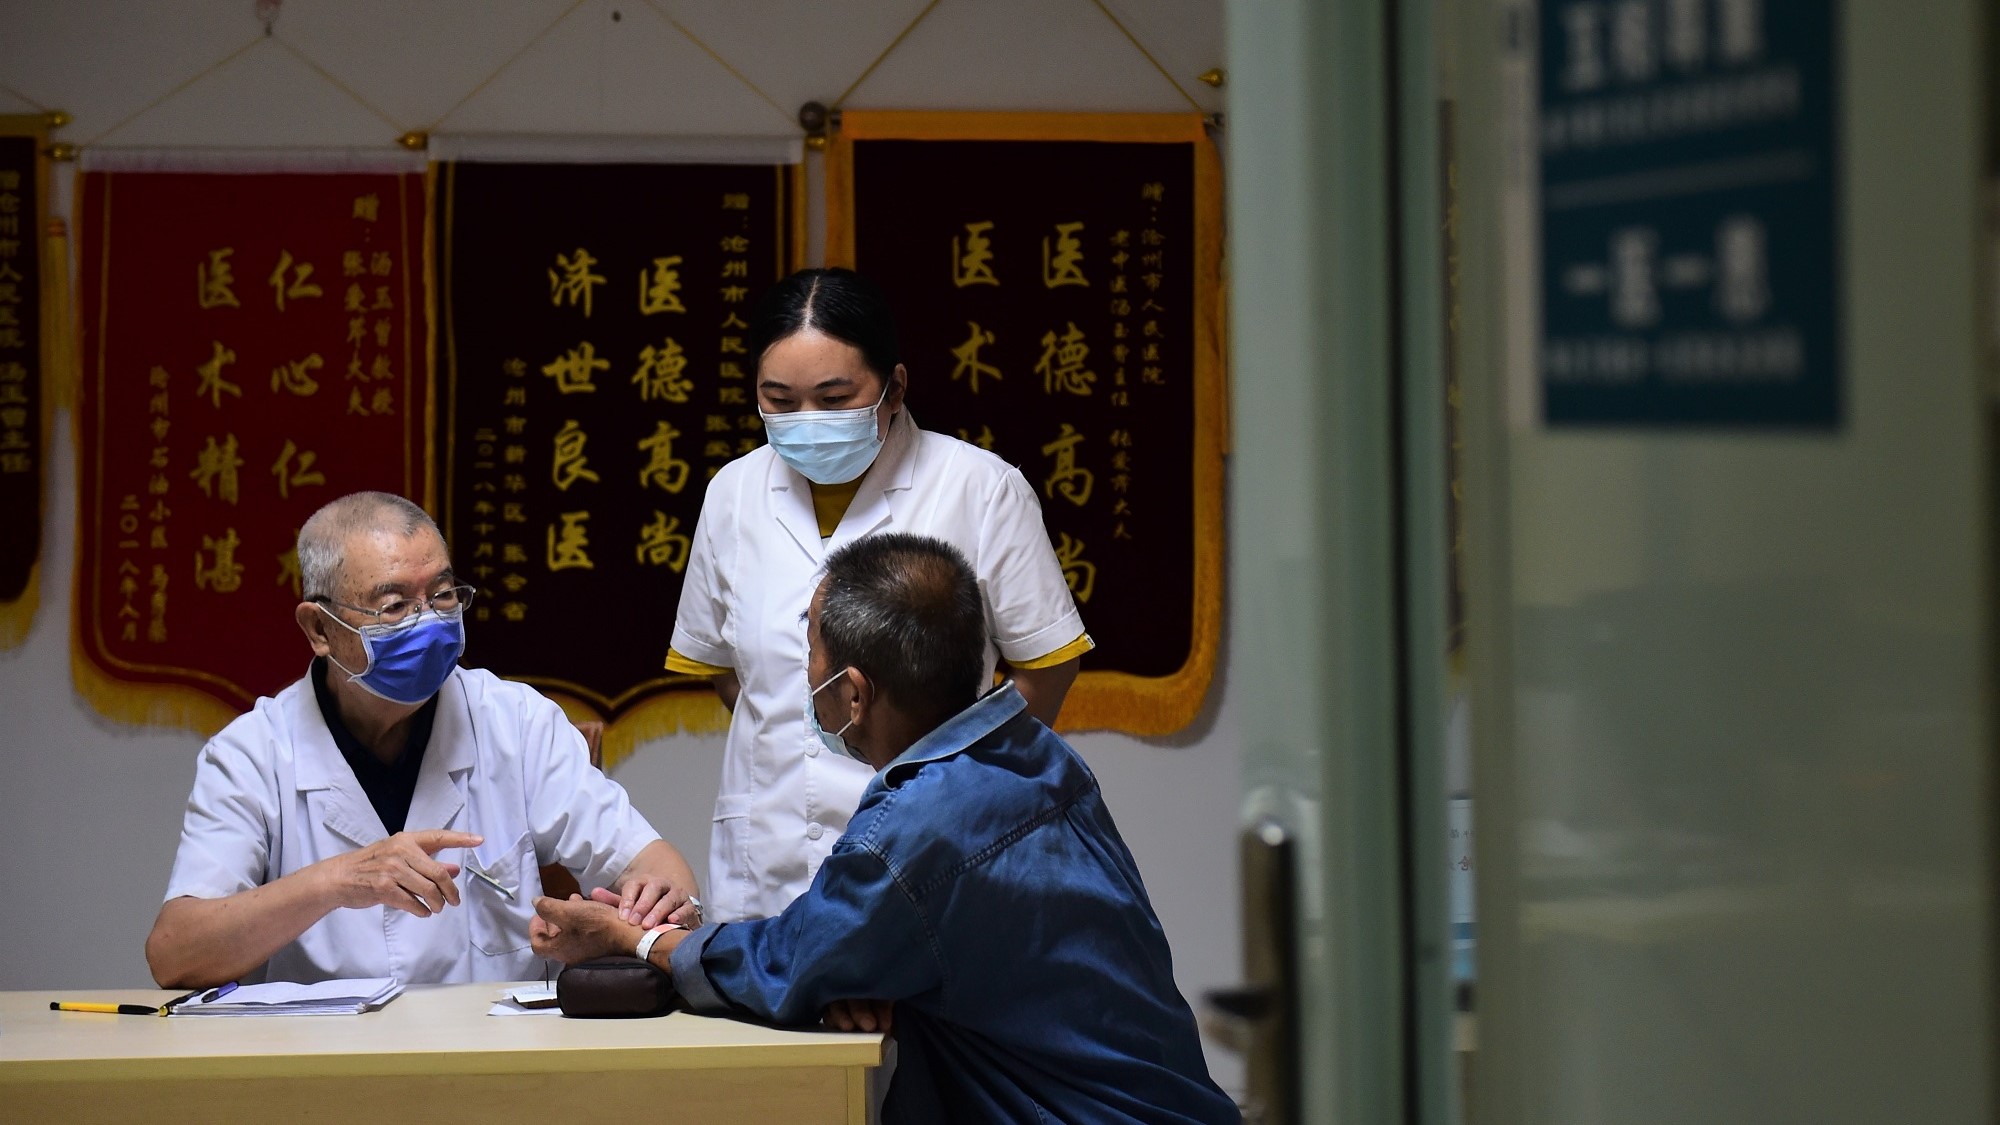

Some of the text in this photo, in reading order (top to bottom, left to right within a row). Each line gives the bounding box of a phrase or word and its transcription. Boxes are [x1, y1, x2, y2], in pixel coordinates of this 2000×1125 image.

[190, 247, 244, 594] 医术精湛
[541, 248, 610, 572] 济世良医
[631, 255, 695, 573] 医德高尚
[951, 221, 1004, 452] 医术
[1034, 221, 1098, 603] 医德高尚
